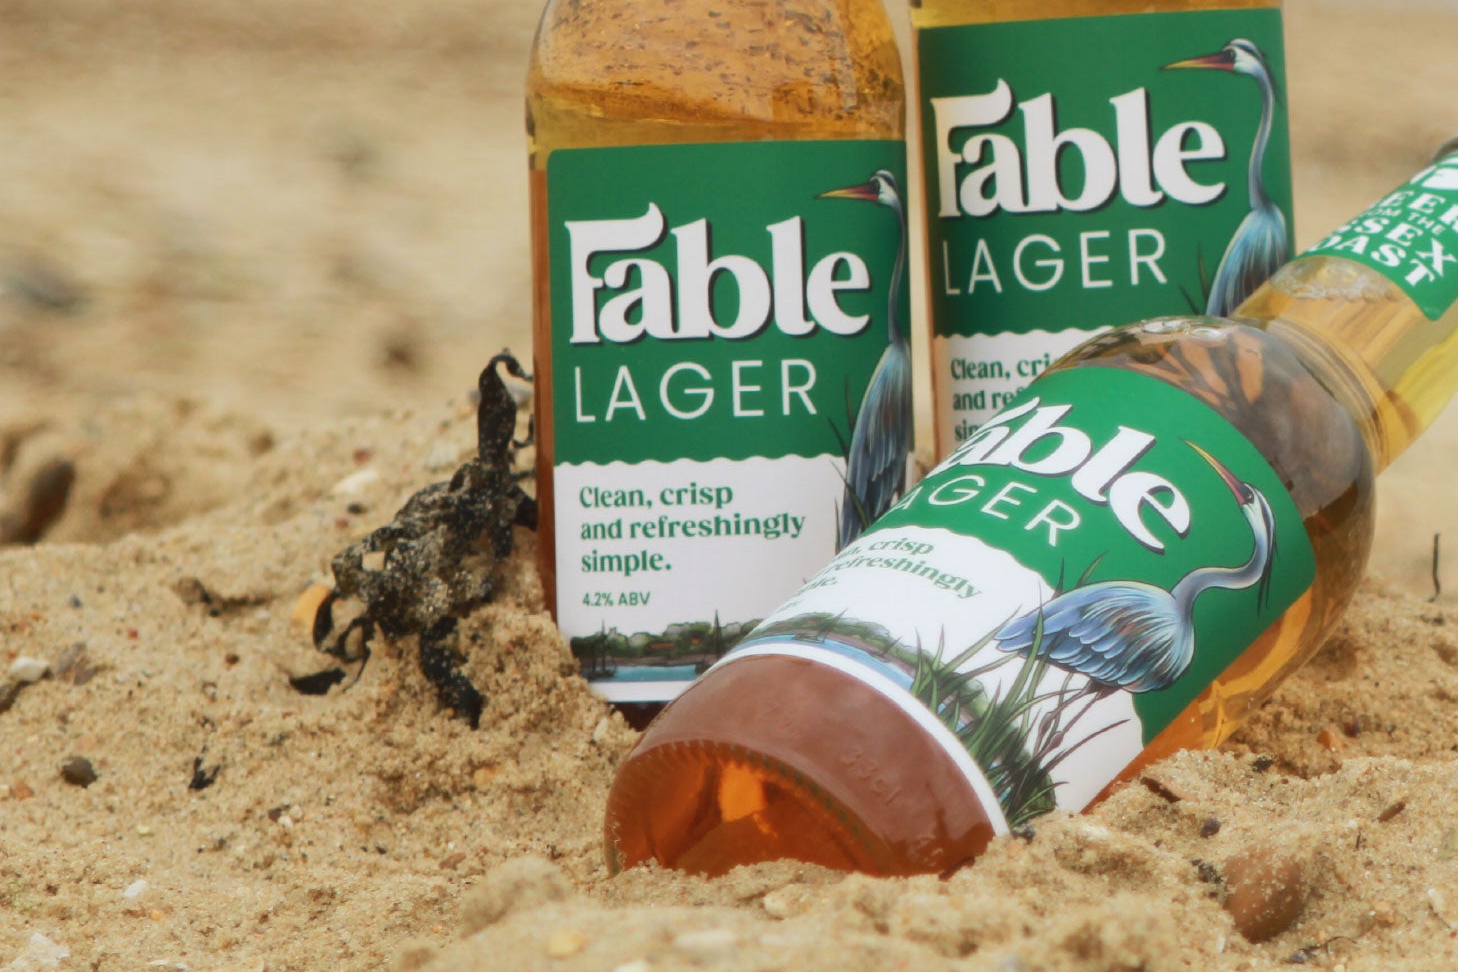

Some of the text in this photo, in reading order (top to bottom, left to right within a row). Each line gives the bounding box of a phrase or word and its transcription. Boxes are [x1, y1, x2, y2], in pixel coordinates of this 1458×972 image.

[930, 78, 1228, 218] Fable
[1407, 211, 1446, 235] THE
[564, 201, 873, 346] Fable
[942, 228, 1168, 295] LAGER
[951, 353, 1055, 380] Clean, cri
[574, 358, 819, 424] LAGER
[953, 391, 986, 411] and
[579, 482, 734, 510] Clean, crisp
[877, 475, 1081, 548] AGER
[581, 513, 807, 540] and refreshingly
[868, 537, 935, 556] crisp
[581, 549, 673, 577] simple.
[582, 591, 651, 607] 4.2% ABV
